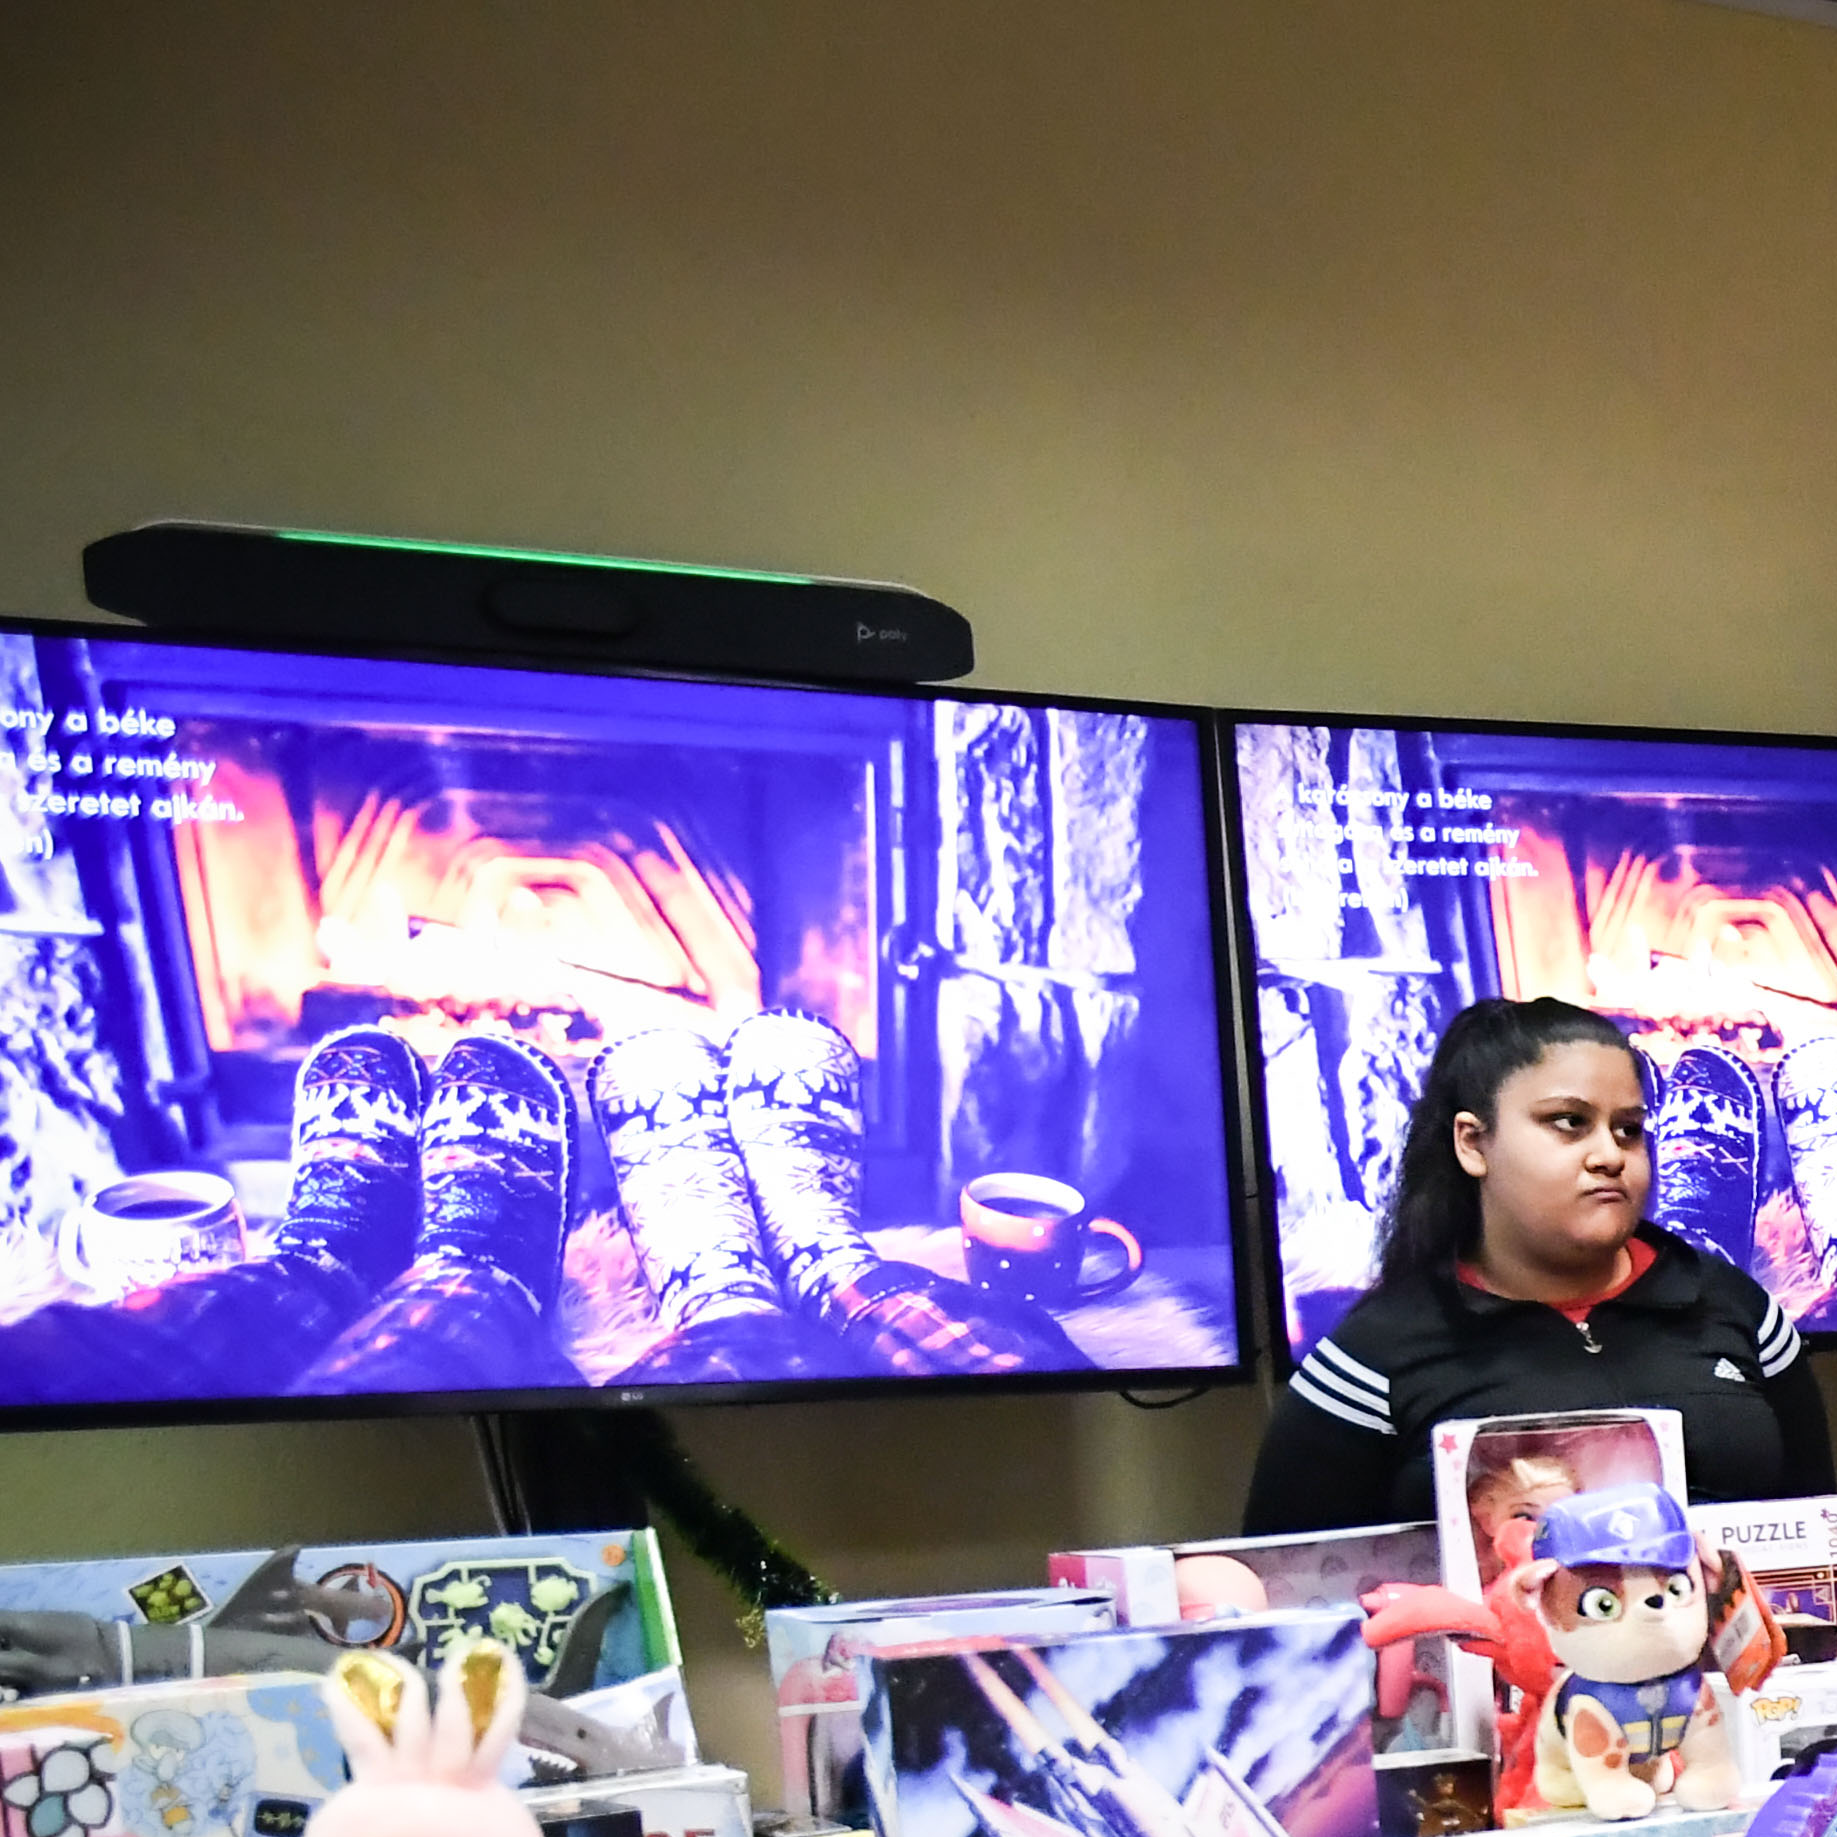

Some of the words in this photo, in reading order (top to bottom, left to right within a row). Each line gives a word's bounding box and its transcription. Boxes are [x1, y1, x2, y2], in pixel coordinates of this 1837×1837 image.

[65, 711, 88, 732] a
[98, 706, 176, 739] béke
[70, 754, 93, 775] a
[103, 751, 216, 786] remény
[151, 791, 245, 825] ajkán.
[1416, 791, 1433, 808] a
[1438, 788, 1493, 810] béke
[1420, 825, 1437, 843] a
[1442, 822, 1520, 849] remény
[1474, 857, 1539, 882] ajkán.
[1722, 1520, 1807, 1545] PUZZLE
